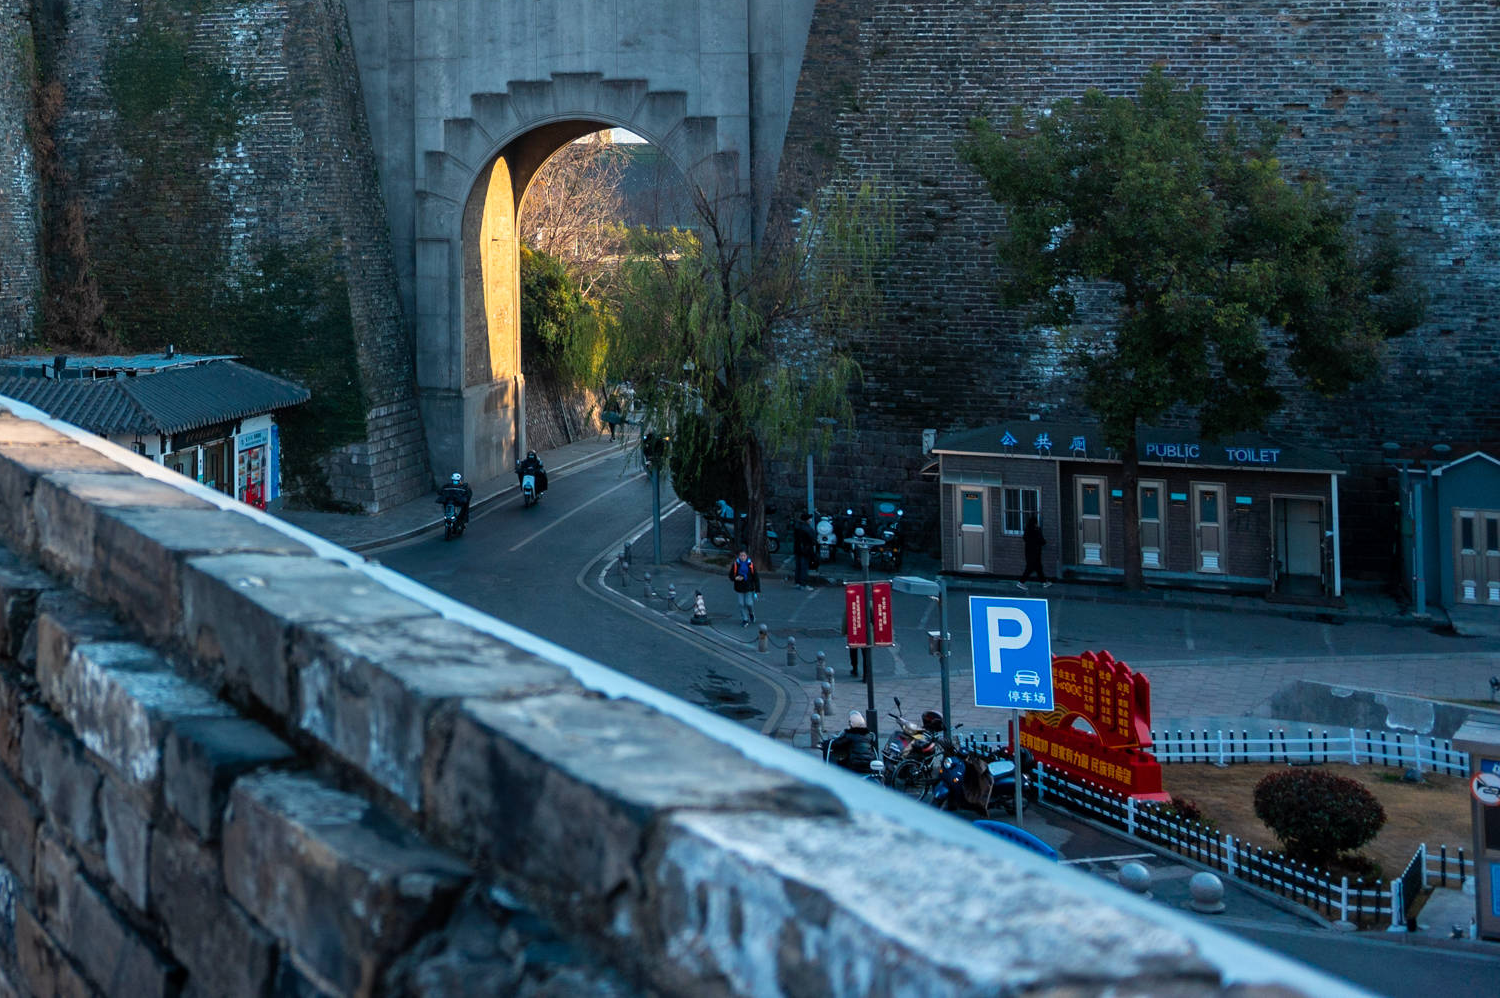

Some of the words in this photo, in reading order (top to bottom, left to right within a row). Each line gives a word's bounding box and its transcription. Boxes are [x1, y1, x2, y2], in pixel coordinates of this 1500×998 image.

[1146, 443, 1200, 458] PUBLIC
[1225, 448, 1281, 462] TOILET
[986, 606, 1033, 674] P
[1008, 689, 1046, 704] 停车场
